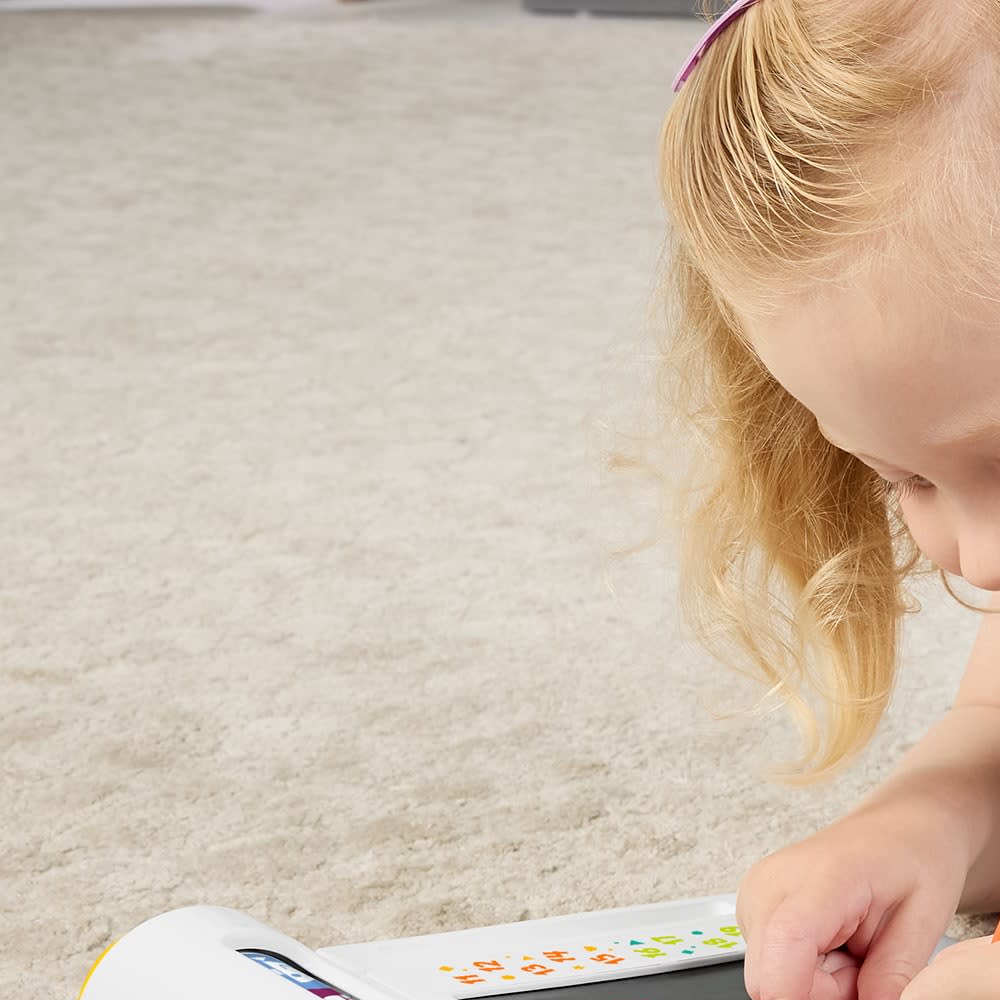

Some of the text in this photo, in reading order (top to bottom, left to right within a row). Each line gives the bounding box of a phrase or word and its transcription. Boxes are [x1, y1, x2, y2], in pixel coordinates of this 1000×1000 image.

[453, 973, 485, 985] 11
[472, 959, 505, 973] 12
[520, 963, 555, 976] 13
[542, 950, 577, 963] 14
[589, 953, 625, 965] 15
[632, 947, 668, 959] 16
[650, 935, 684, 945] 17
[702, 937, 738, 949] 18
